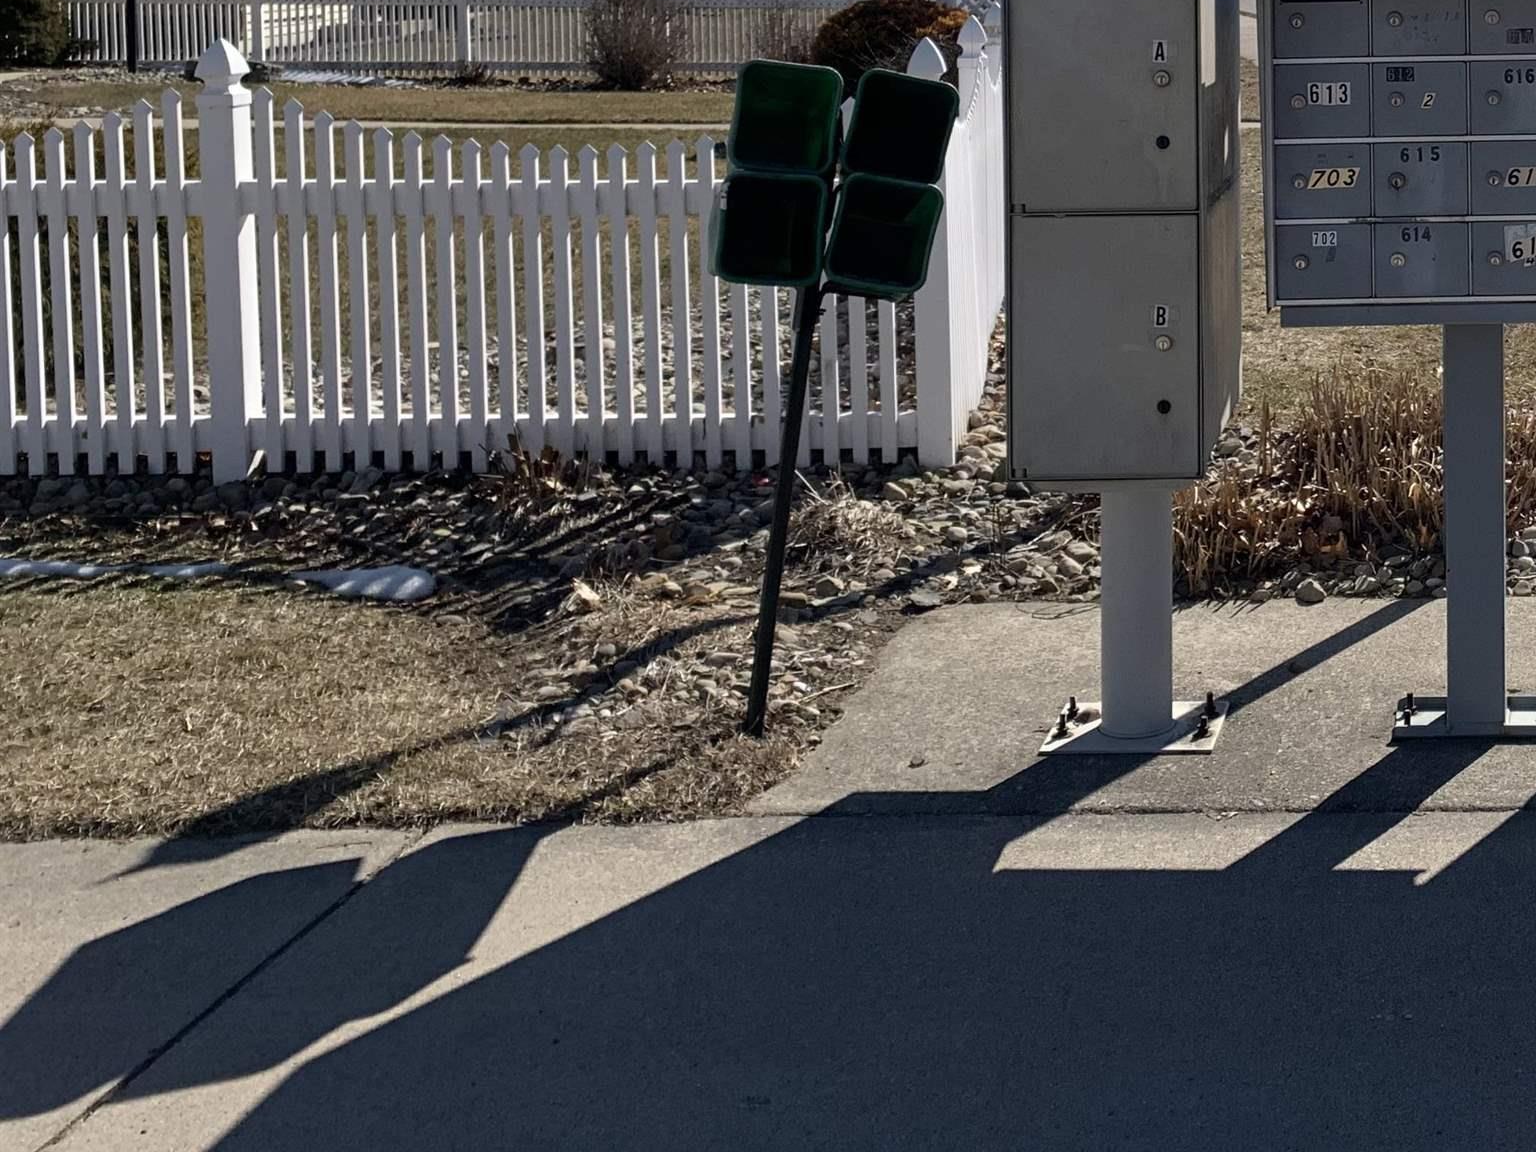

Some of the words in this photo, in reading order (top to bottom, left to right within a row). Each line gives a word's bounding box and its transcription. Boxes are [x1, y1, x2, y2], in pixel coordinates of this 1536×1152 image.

[1154, 41, 1165, 61] A
[1504, 68, 1535, 84] 616
[1310, 83, 1348, 104] 613
[1423, 94, 1434, 107] 2
[1400, 146, 1440, 162] 615
[1311, 168, 1356, 188] 703
[1313, 232, 1336, 245] 702
[1401, 226, 1432, 243] 614
[1155, 306, 1166, 326] B
